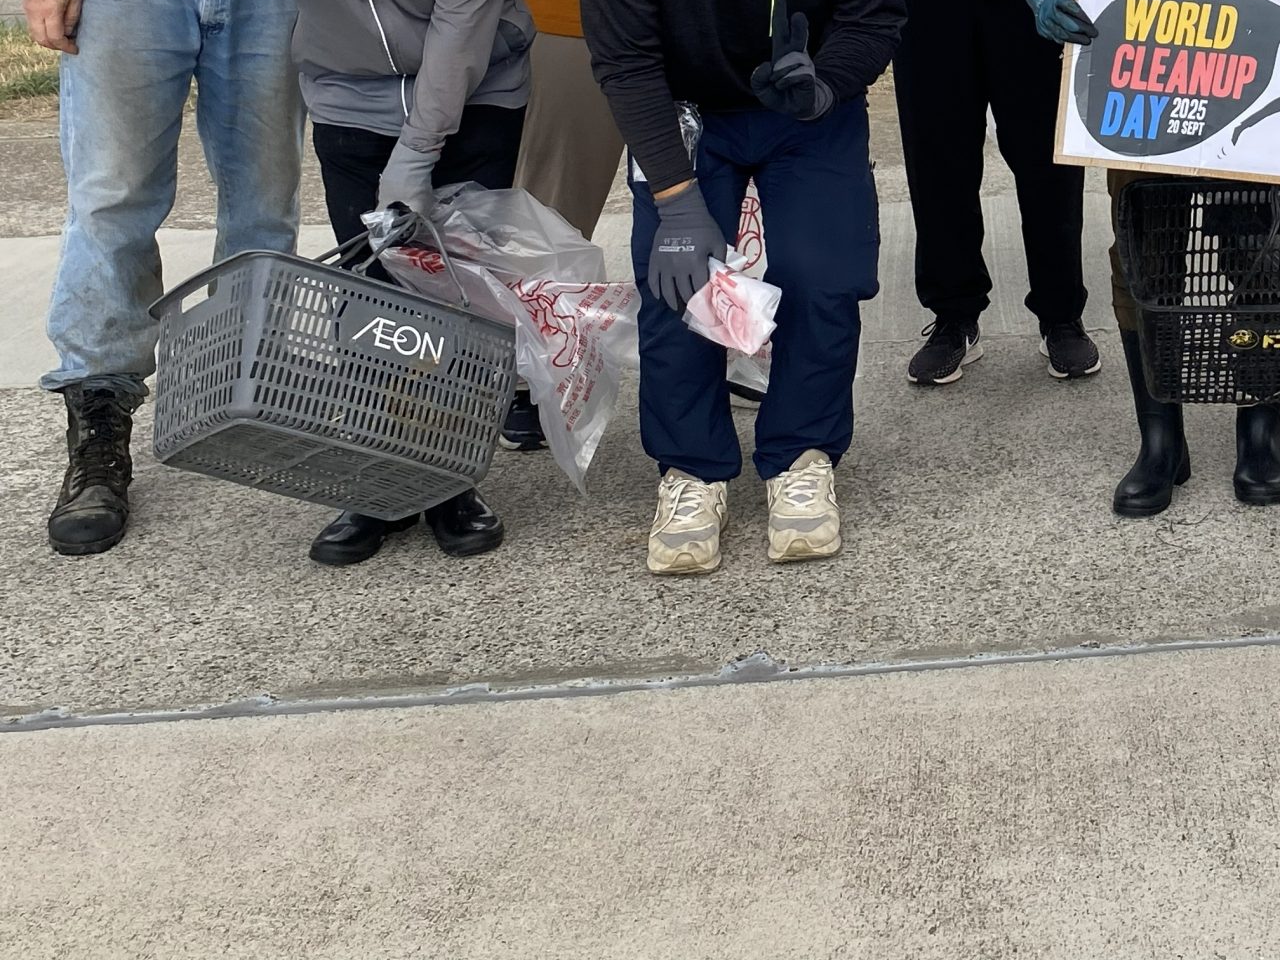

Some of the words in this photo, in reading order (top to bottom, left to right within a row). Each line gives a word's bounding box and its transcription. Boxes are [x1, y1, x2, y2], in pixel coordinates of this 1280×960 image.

[1110, 43, 1258, 100] CLEANUP
[1100, 91, 1170, 140] DAY
[1170, 97, 1208, 120] 2025
[1167, 119, 1179, 134] 20
[1181, 120, 1205, 136] SEPT
